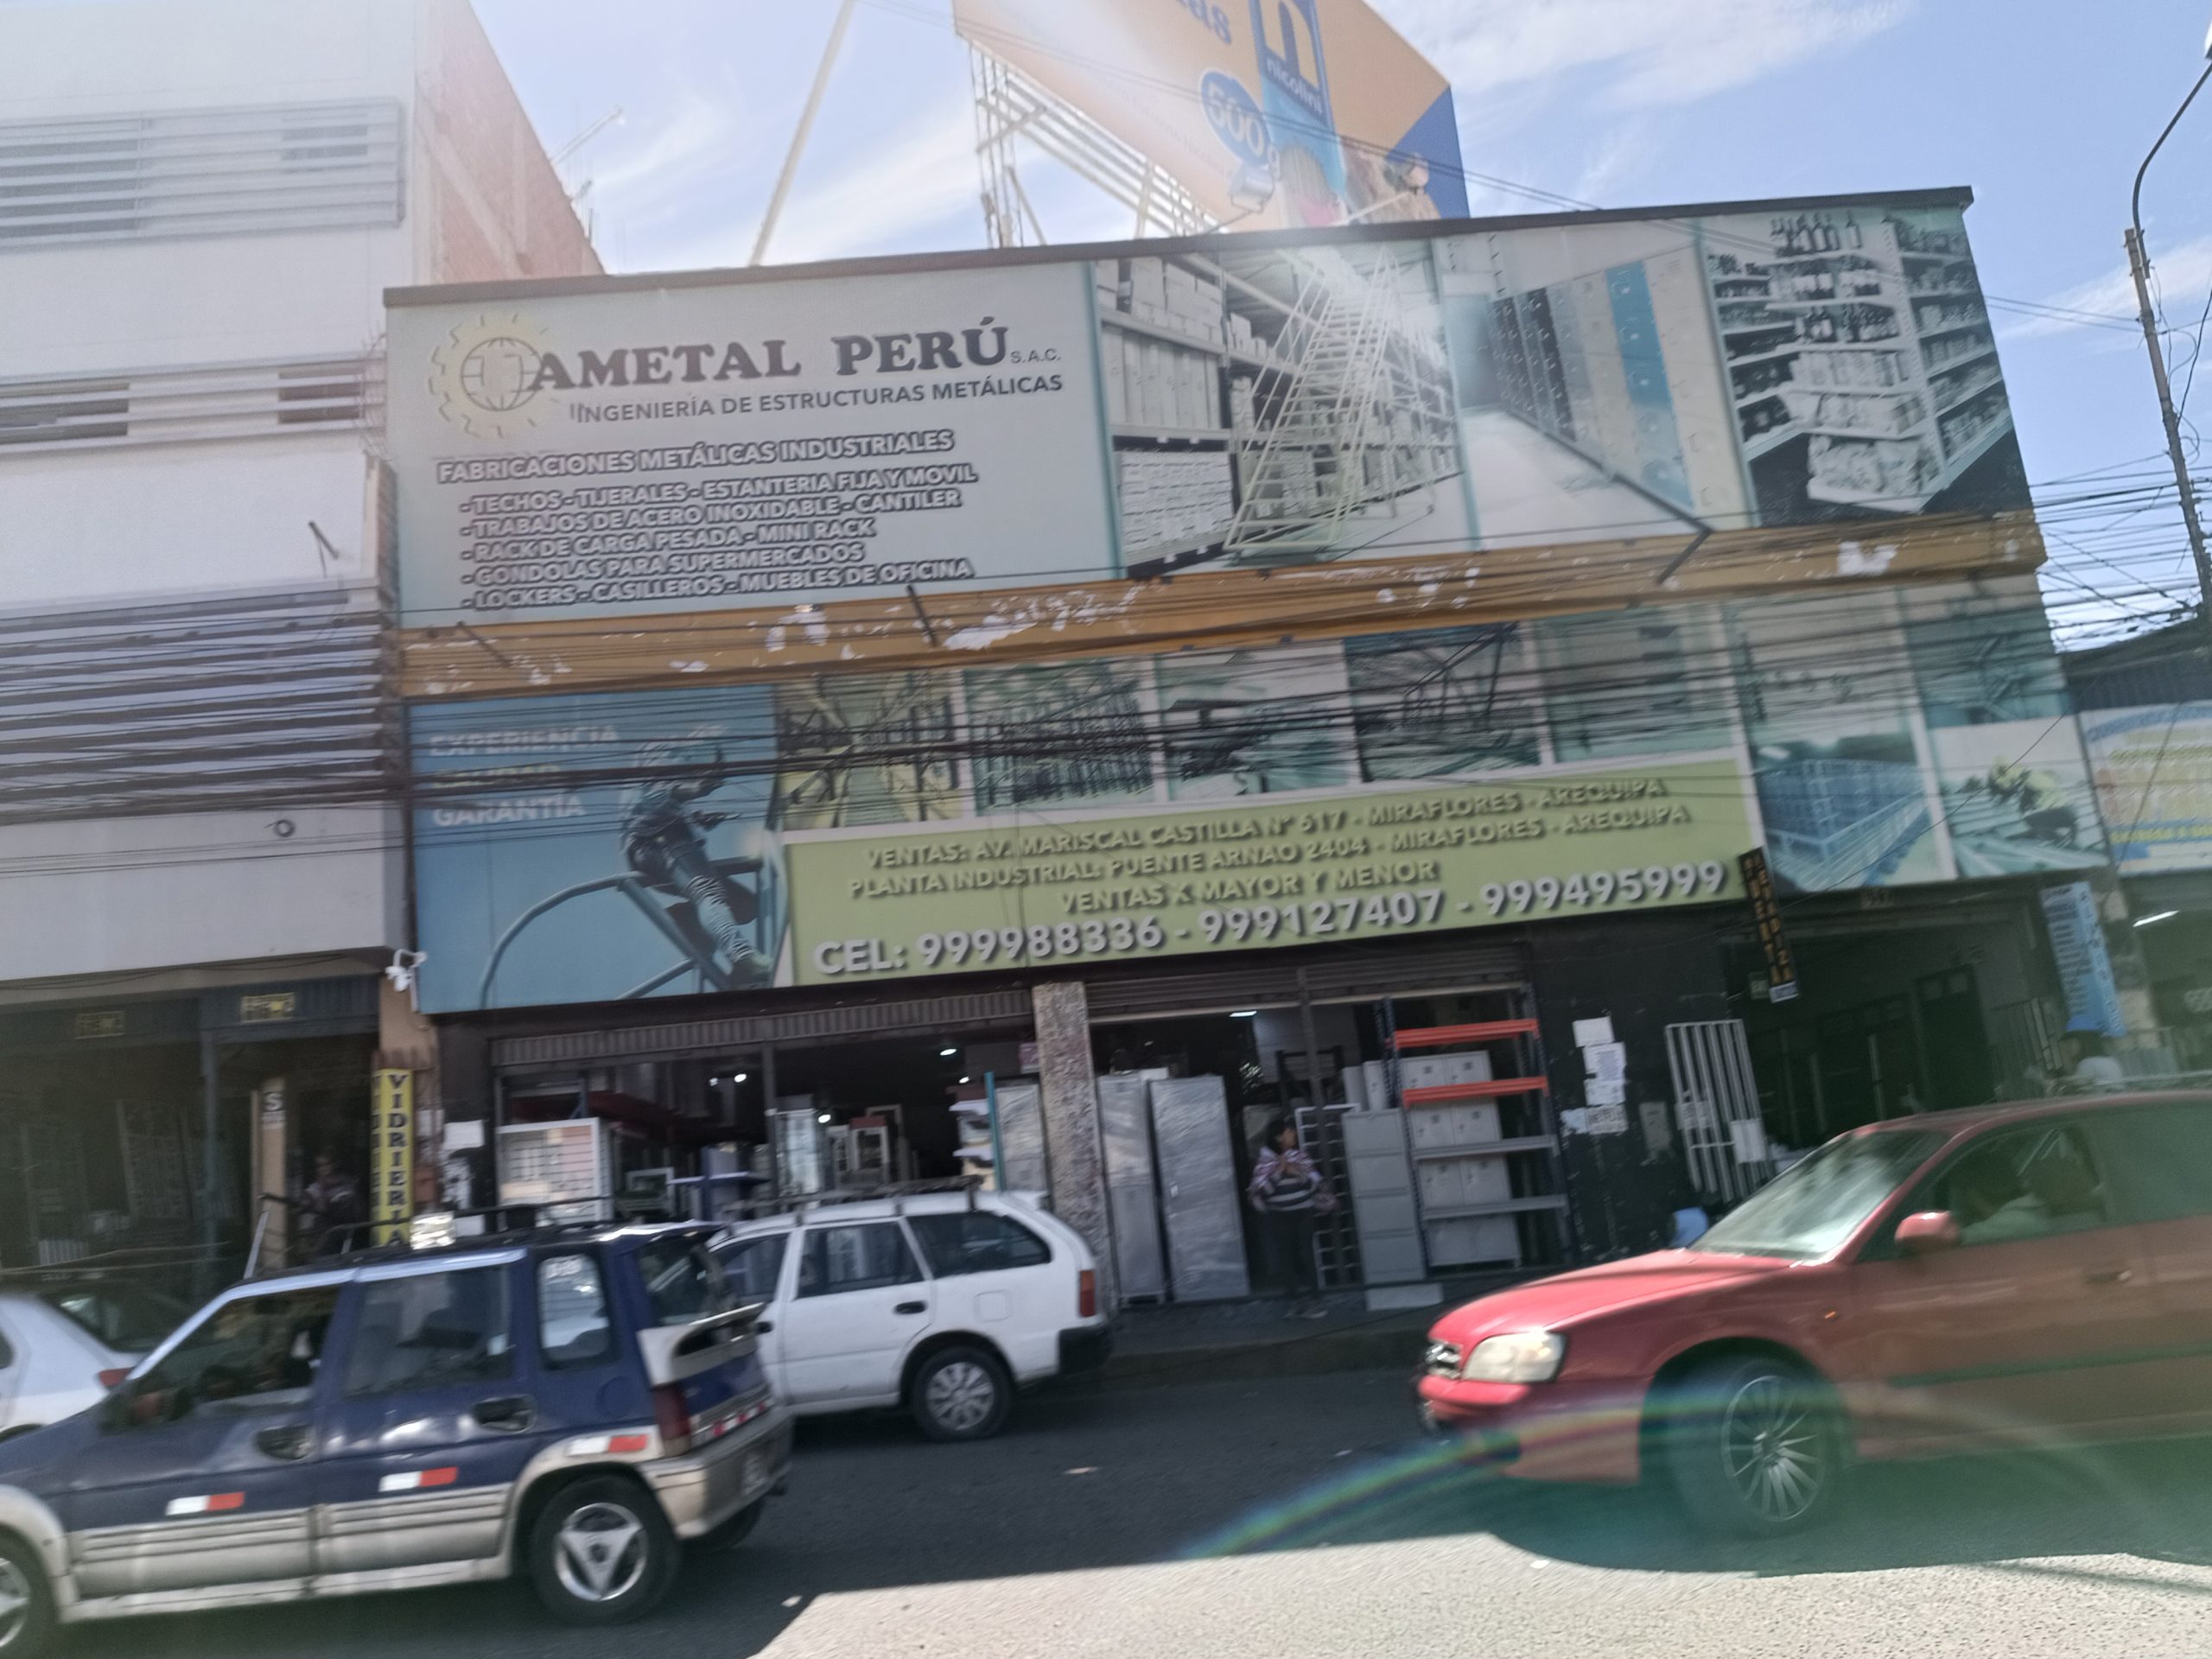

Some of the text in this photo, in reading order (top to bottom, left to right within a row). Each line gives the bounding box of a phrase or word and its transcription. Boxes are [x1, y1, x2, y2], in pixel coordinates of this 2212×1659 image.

[525, 316, 1061, 390] AMETAL PERÚ S.A.C.
[570, 374, 1063, 423] INGENIERÍA DE ESTRUCTURAS METÁLICAS
[437, 429, 954, 484] FABRICACIONES METÁLICAS INDUSTRIALES
[472, 490, 562, 515] TECHOS
[575, 482, 688, 508] TIJERALES
[702, 473, 835, 500] ESTANTERIA
[835, 469, 889, 493] FIJA
[886, 468, 907, 489] Y
[906, 463, 978, 486] MOVIL
[472, 513, 589, 539] TRABAJOS
[591, 510, 624, 530] DE
[626, 505, 702, 527] ACERO
[707, 496, 840, 524] INOXIDABLE
[855, 488, 962, 513] CANTILER
[474, 539, 538, 562] RACK
[539, 536, 572, 557] DE
[573, 532, 653, 555] CARGA
[655, 525, 745, 550] PESADA
[757, 521, 810, 544] MINI
[814, 517, 877, 540] RACK
[474, 559, 605, 587] GONDOLAS
[606, 555, 665, 578] PARA
[667, 542, 866, 574] SUPERMERCADOS
[474, 584, 577, 611] LOCKERS
[590, 575, 725, 602] CASILLEROS
[738, 567, 842, 593] MUEBLES
[842, 564, 877, 586] DE
[878, 557, 975, 583] OFICINA
[866, 842, 967, 869] VENTAS:
[976, 838, 1013, 861] AV.
[1020, 828, 1141, 856] MARISCAL
[1149, 819, 1260, 847] CASTILLA
[1368, 792, 1522, 827] MIRAFLORES
[1541, 779, 1669, 809] AREQUIPA
[849, 873, 948, 900] PLANTA
[1110, 852, 1207, 878] PUENTE
[1211, 842, 1300, 869] ARNAO
[1306, 835, 1370, 861] 2404
[1391, 818, 1544, 853] MIRAFLORES
[1564, 804, 1690, 835] AREQUIPA
[1059, 860, 1440, 915] VENTAS X MAYOR Y MENOR
[813, 938, 908, 975] CEL:
[918, 915, 1163, 967] 999988336
[1197, 890, 1443, 944] 999127407
[1480, 861, 1725, 917] 999495999
